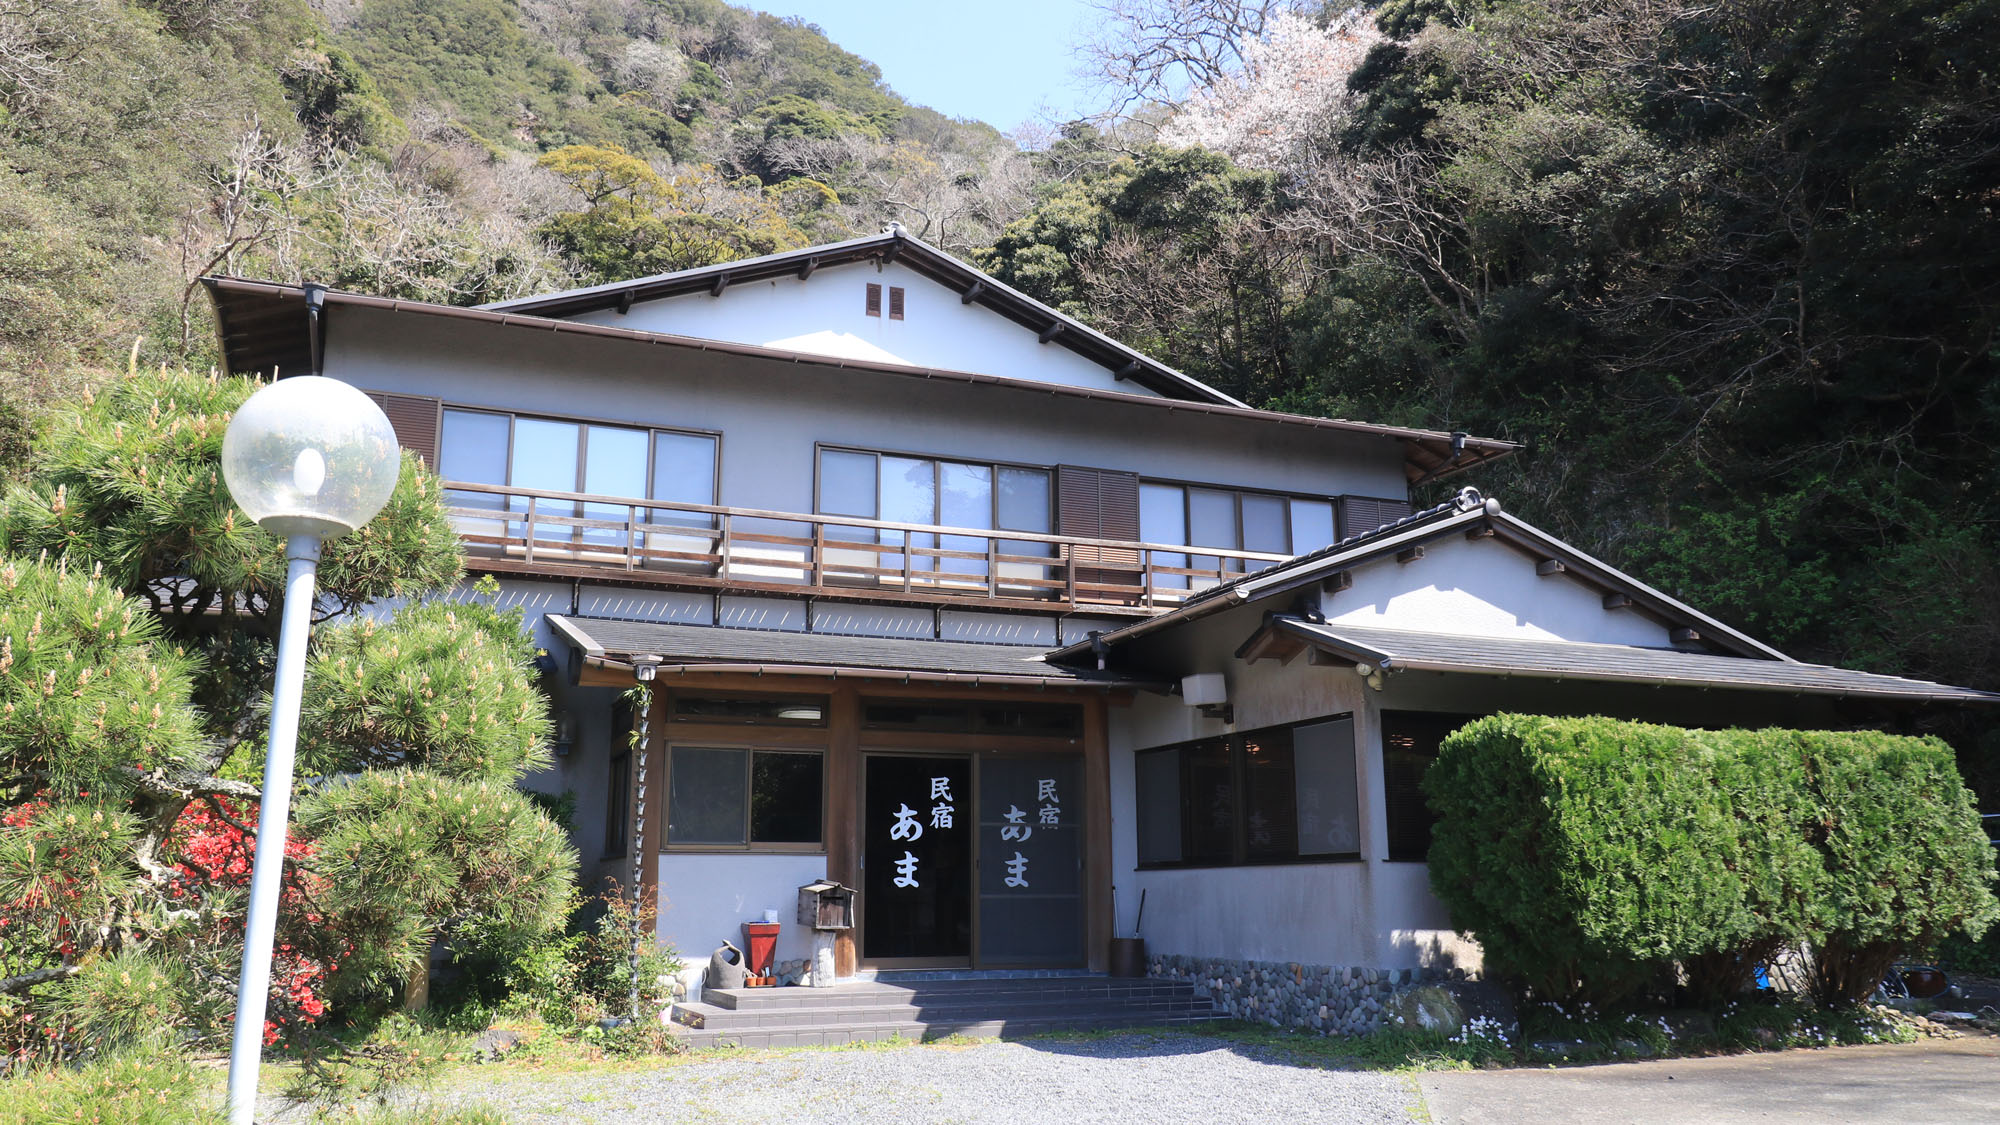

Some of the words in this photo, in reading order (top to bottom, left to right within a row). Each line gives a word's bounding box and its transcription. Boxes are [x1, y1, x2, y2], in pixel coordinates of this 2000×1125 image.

[930, 776, 955, 829] 民宿
[1038, 779, 1061, 830] 民宿
[889, 803, 923, 888] あま
[1001, 804, 1032, 888] あま
